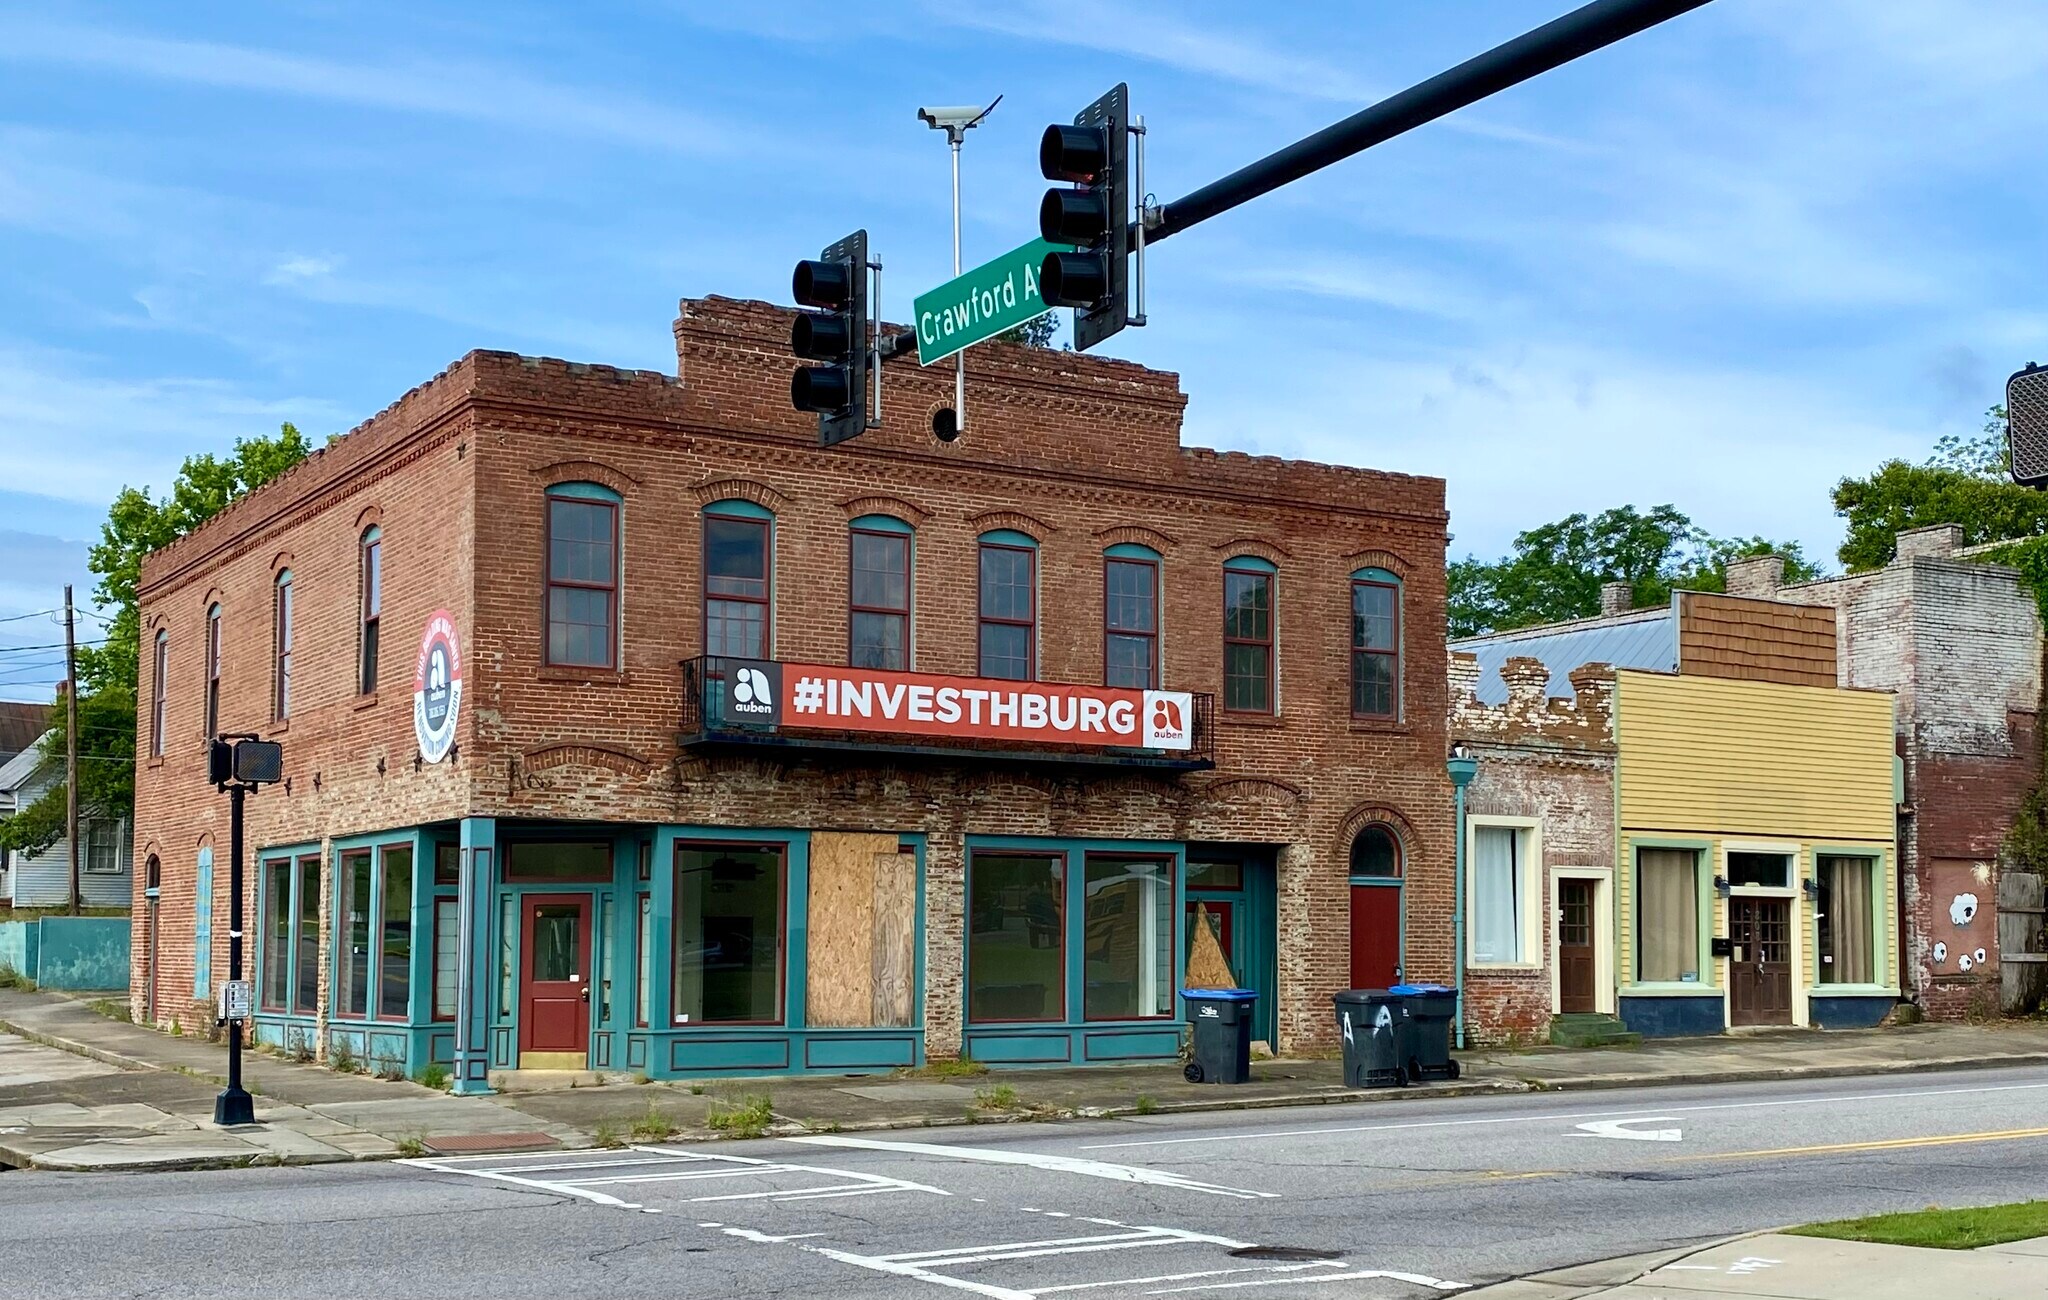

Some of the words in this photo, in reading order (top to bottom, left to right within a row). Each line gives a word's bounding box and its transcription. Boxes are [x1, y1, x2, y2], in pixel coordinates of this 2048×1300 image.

[921, 271, 1016, 345] Crawford
[735, 701, 772, 714] auben
[793, 676, 1136, 735] #INVESTHBURG
[1153, 729, 1183, 739] auben
[1373, 1005, 1393, 1039] A
